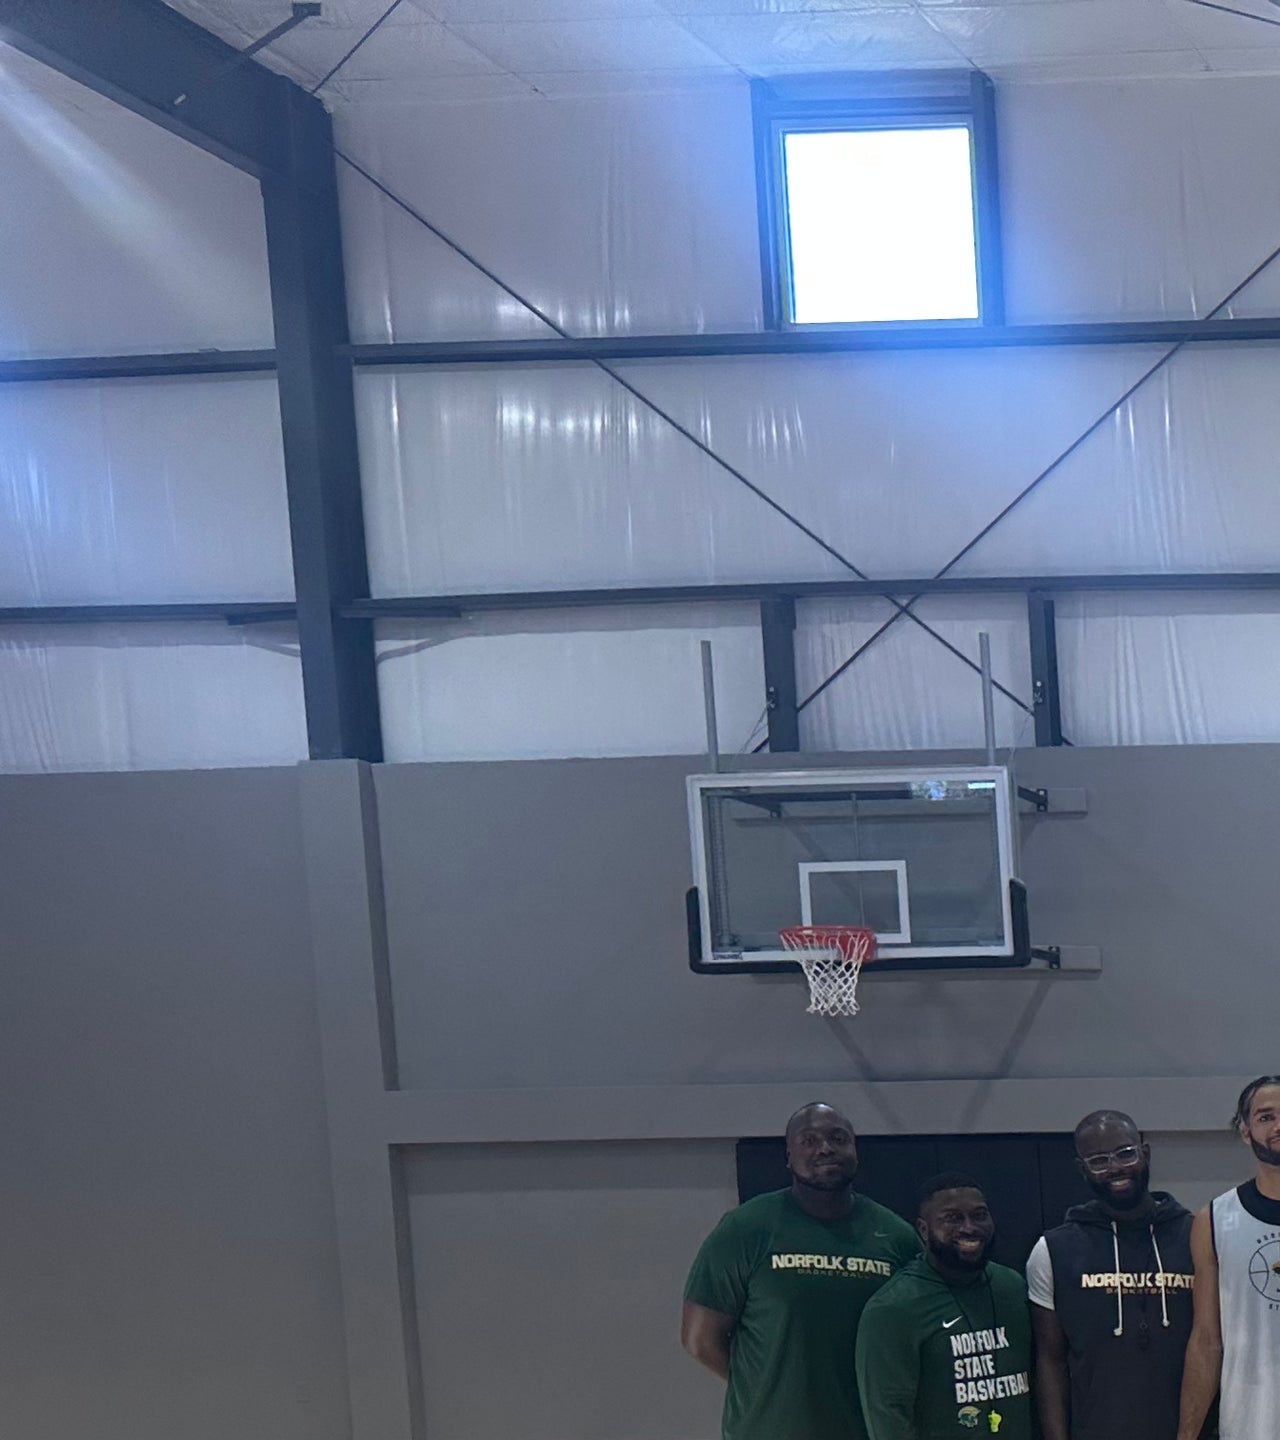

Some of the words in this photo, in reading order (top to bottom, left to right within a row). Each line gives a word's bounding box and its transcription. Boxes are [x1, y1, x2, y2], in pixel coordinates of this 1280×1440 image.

[771, 1254, 844, 1271] NORFOLK
[846, 1257, 891, 1276] STATE
[1082, 1272, 1153, 1288] NORFOLK
[950, 1327, 1010, 1357] NORFOLK
[954, 1354, 996, 1379] STATE
[955, 1371, 1030, 1404] BASKETBA
